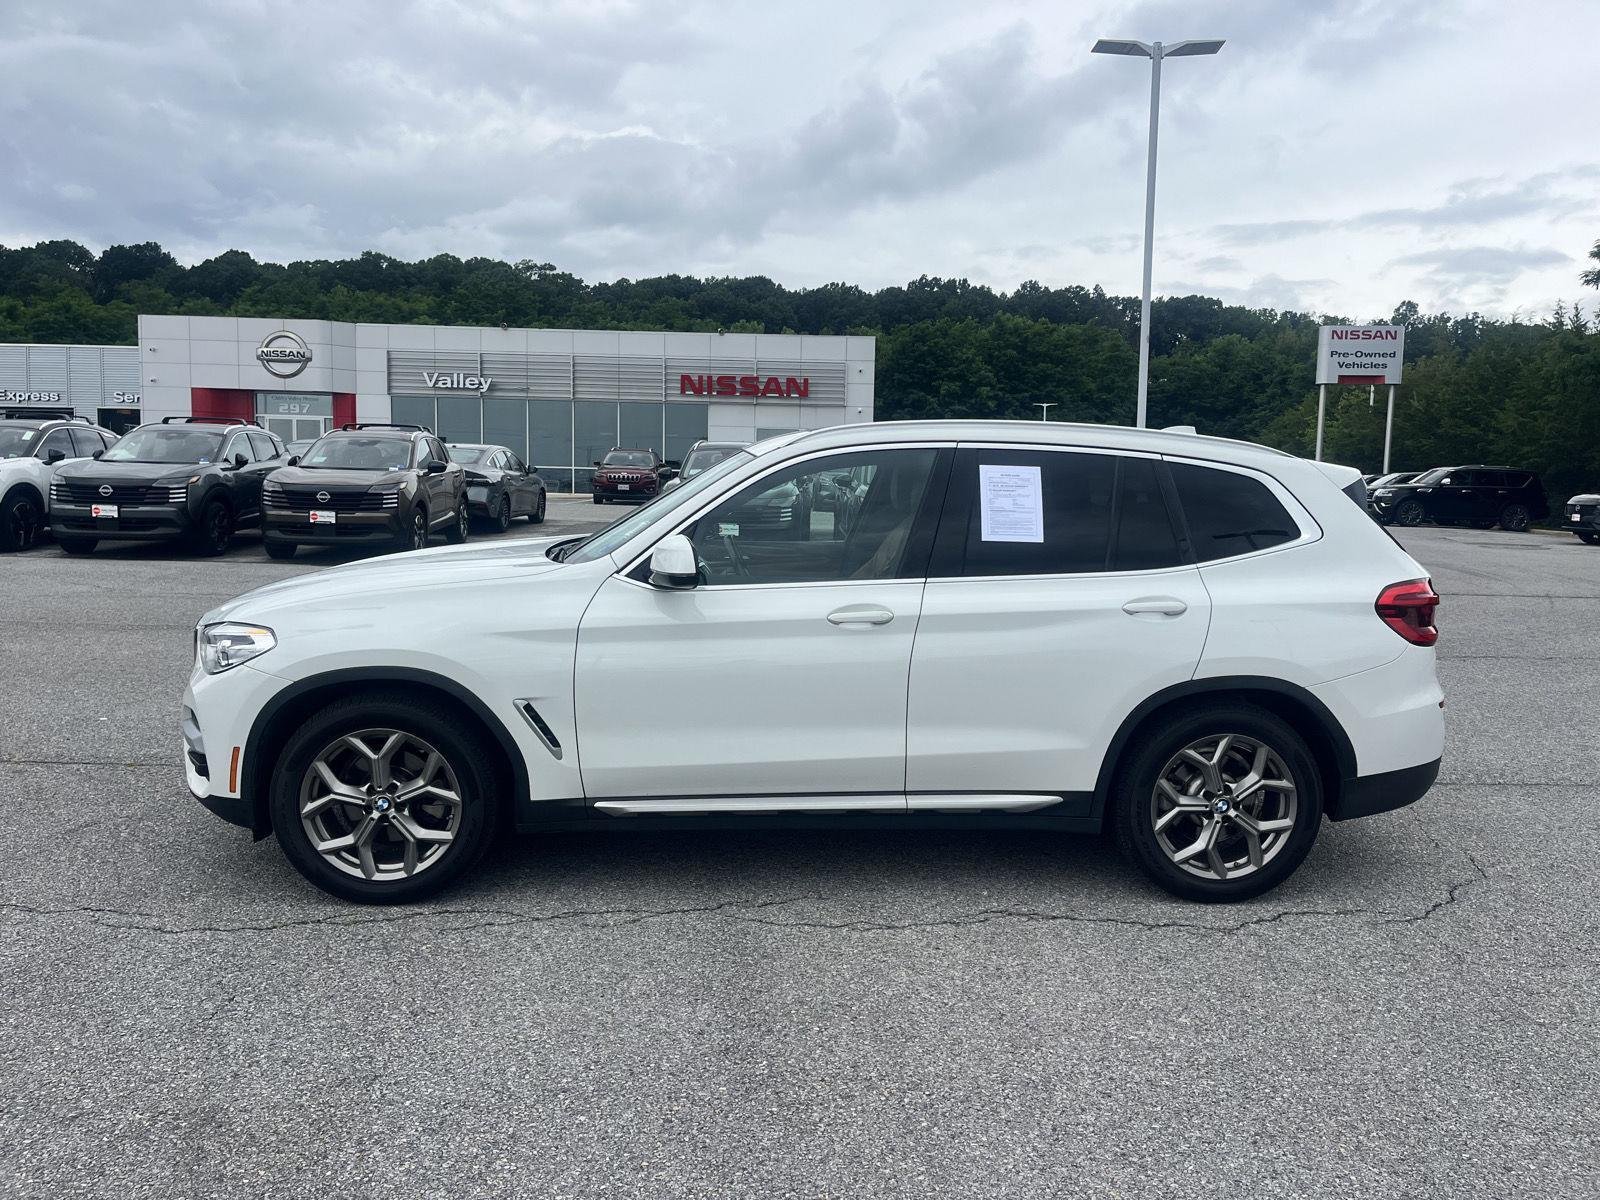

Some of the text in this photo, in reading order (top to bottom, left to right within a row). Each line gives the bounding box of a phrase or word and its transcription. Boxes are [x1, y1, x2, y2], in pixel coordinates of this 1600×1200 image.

[1331, 330, 1397, 340] NISSAN
[260, 350, 306, 358] NISSAN
[1330, 350, 1396, 358] Pre-Owned
[1337, 361, 1388, 369] Vehicles
[423, 372, 492, 393] Valley
[680, 374, 809, 398] NISSAN
[0, 390, 60, 403] Express
[279, 403, 311, 413] 297
